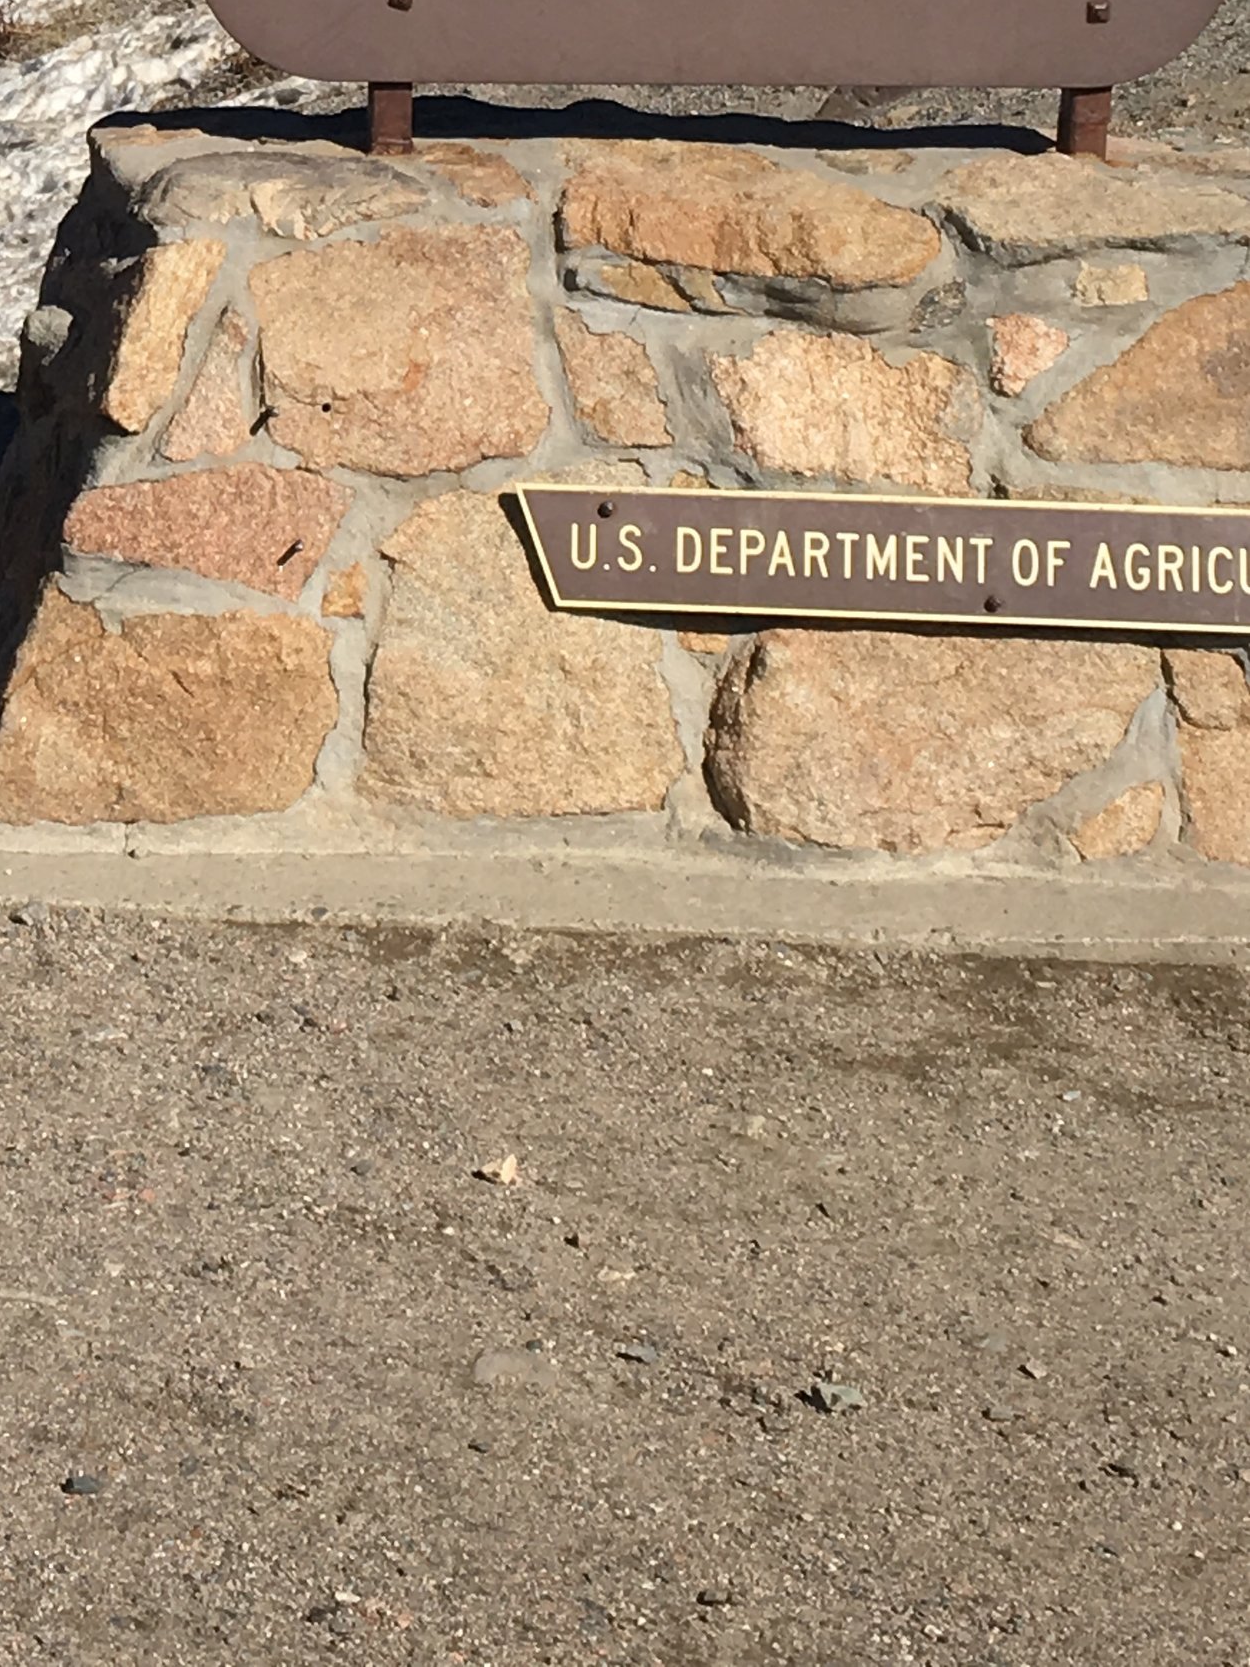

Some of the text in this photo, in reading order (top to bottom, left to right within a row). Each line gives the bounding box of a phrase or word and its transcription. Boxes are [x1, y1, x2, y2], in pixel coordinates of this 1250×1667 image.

[570, 522, 657, 572] U.S.
[676, 526, 993, 584] DEPARTMENT
[1012, 538, 1071, 587] OF
